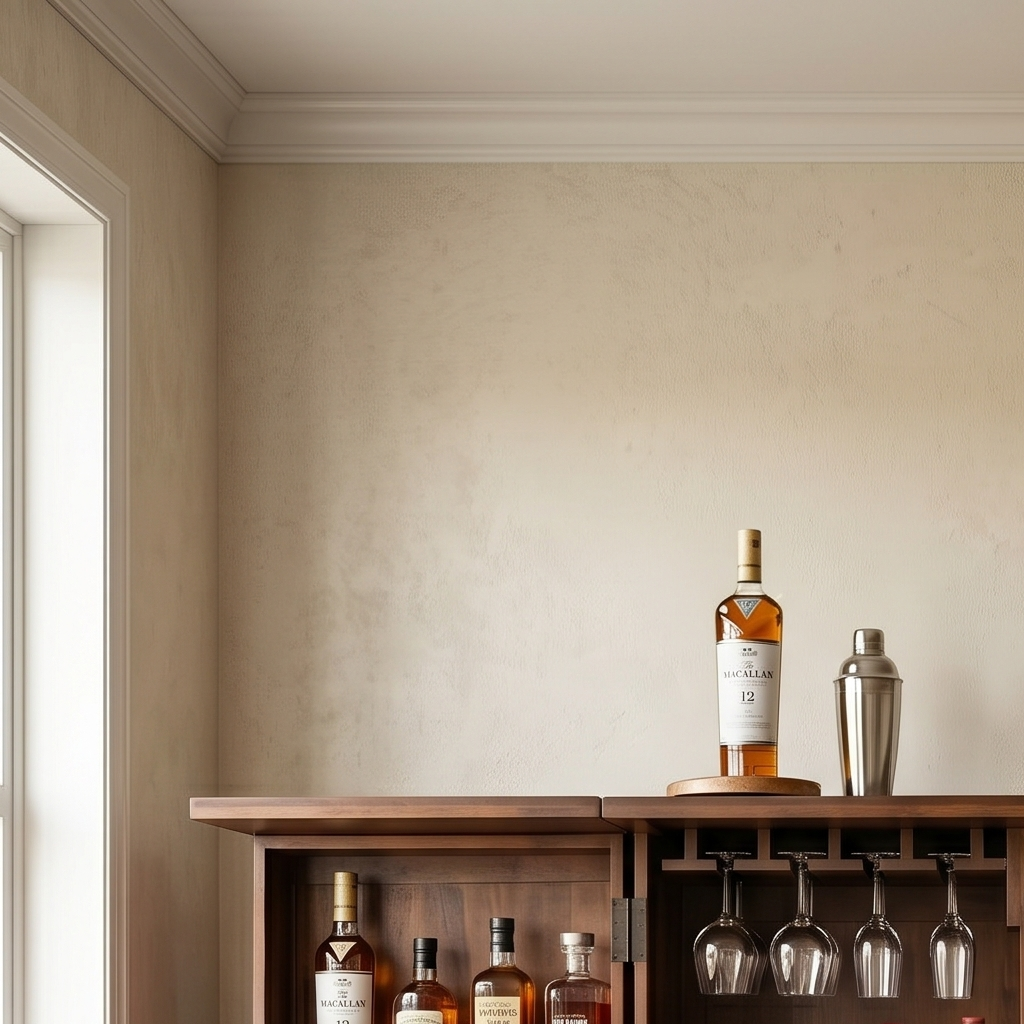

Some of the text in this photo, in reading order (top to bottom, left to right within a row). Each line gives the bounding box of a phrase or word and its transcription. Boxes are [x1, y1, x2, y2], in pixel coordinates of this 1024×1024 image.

[723, 670, 774, 679] MACALLAN
[741, 690, 755, 702] 12
[321, 1000, 366, 1008] MACALLAN
